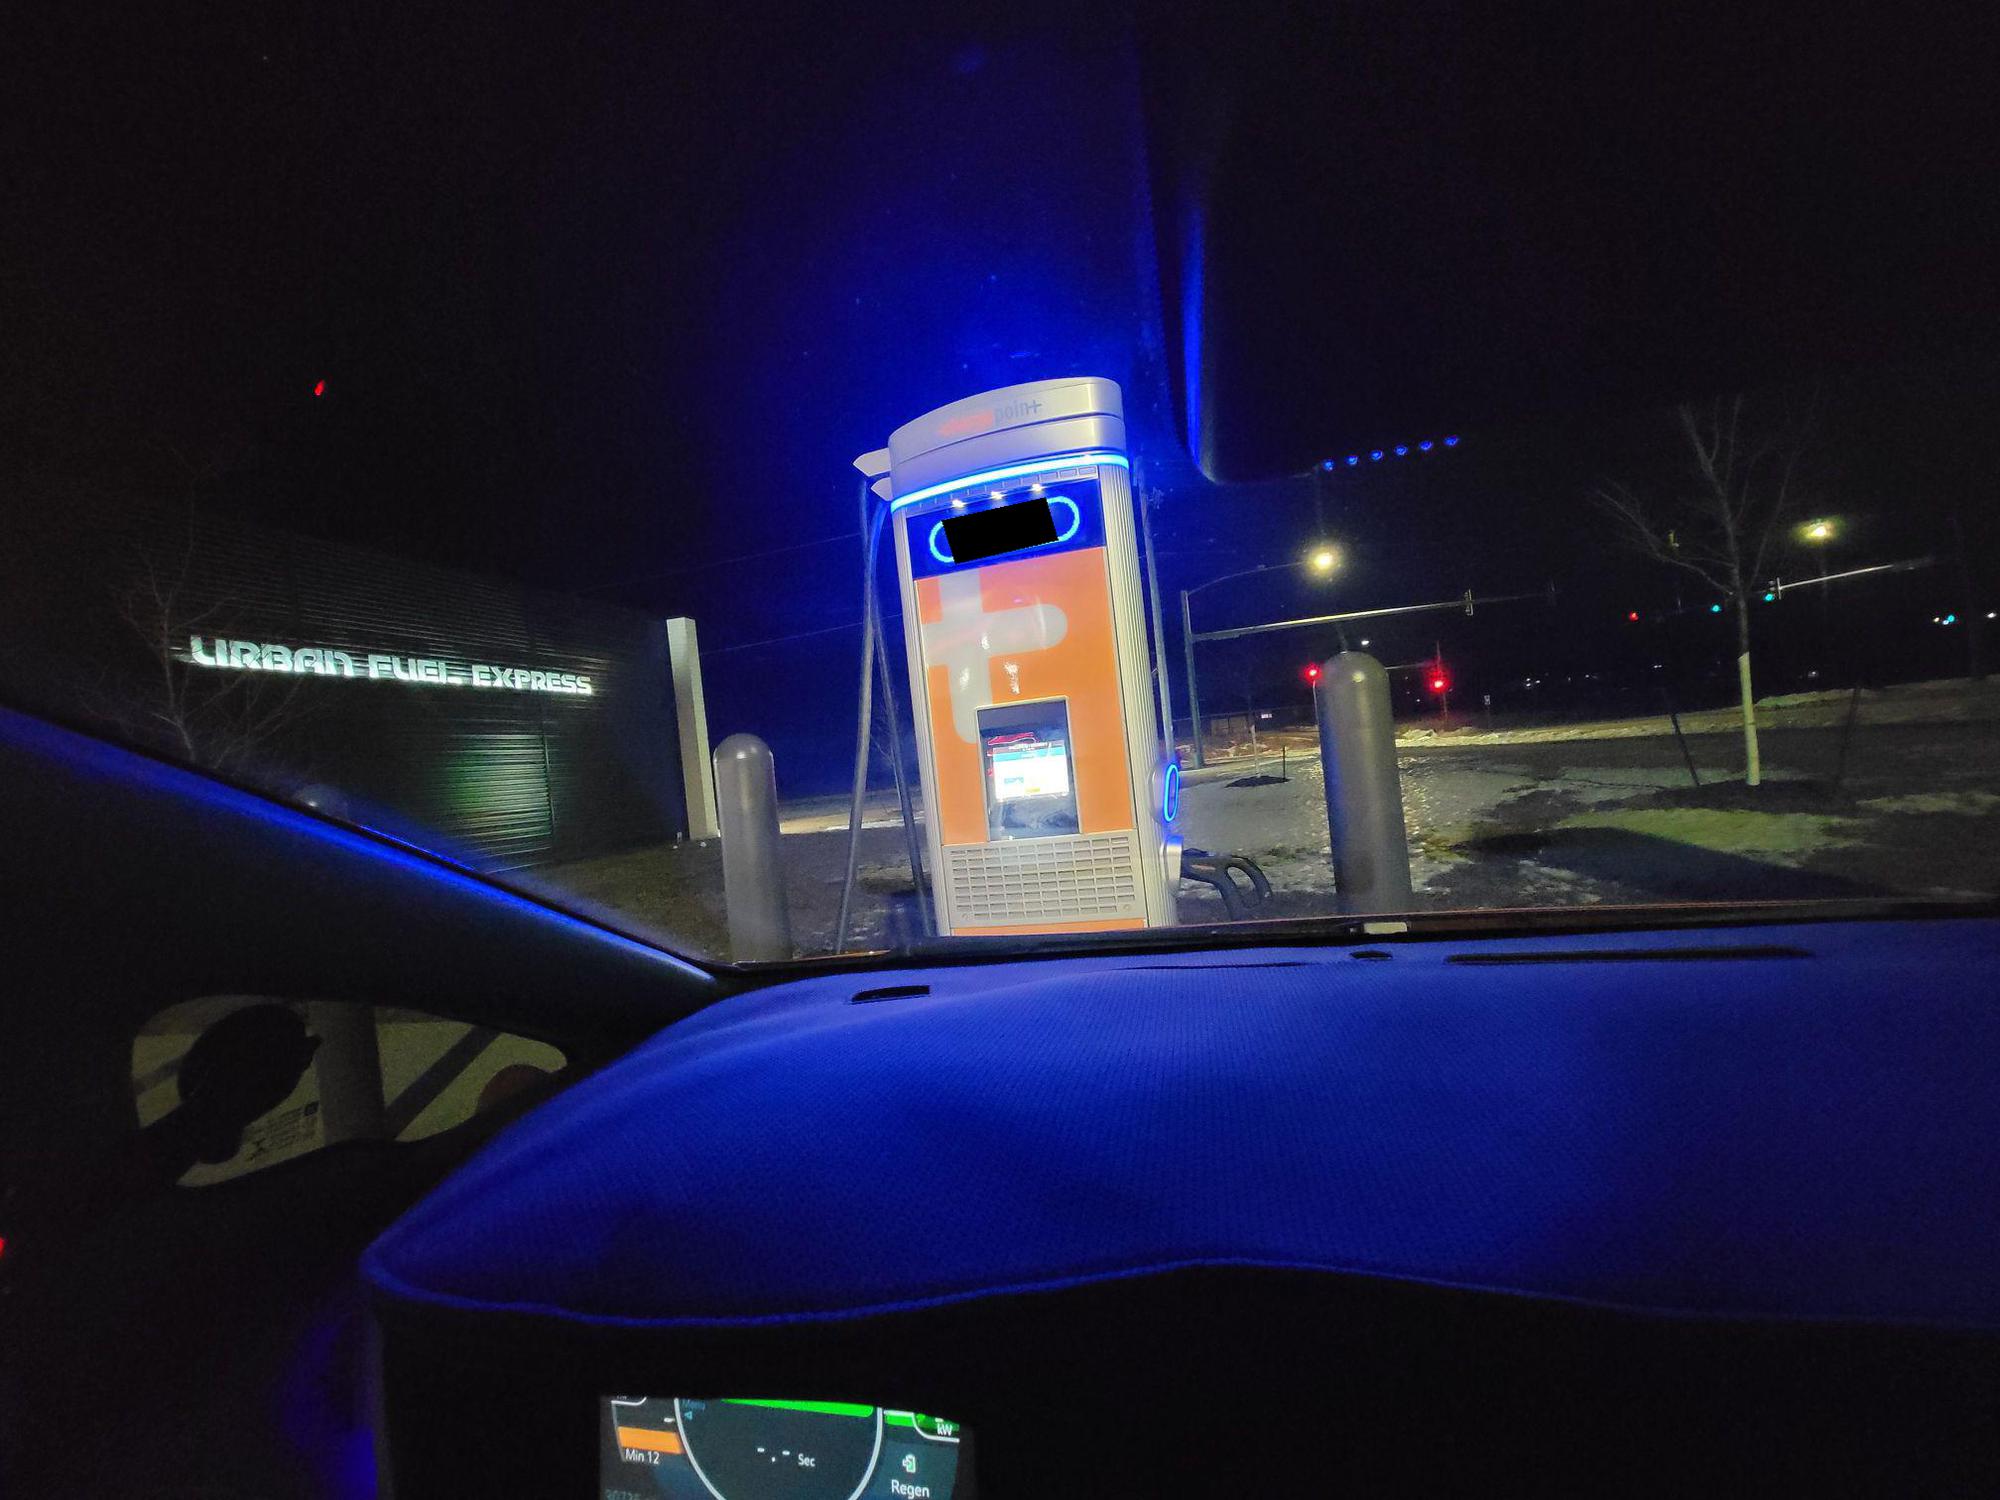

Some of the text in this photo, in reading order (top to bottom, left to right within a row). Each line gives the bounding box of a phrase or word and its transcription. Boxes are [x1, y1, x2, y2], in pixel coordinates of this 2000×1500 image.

[190, 635, 593, 695] URBAN FUEL EXPRESS
[936, 1422, 953, 1436] kW
[625, 1448, 660, 1465] Min 12
[798, 1453, 816, 1468] Sec
[891, 1479, 930, 1499] Regen
